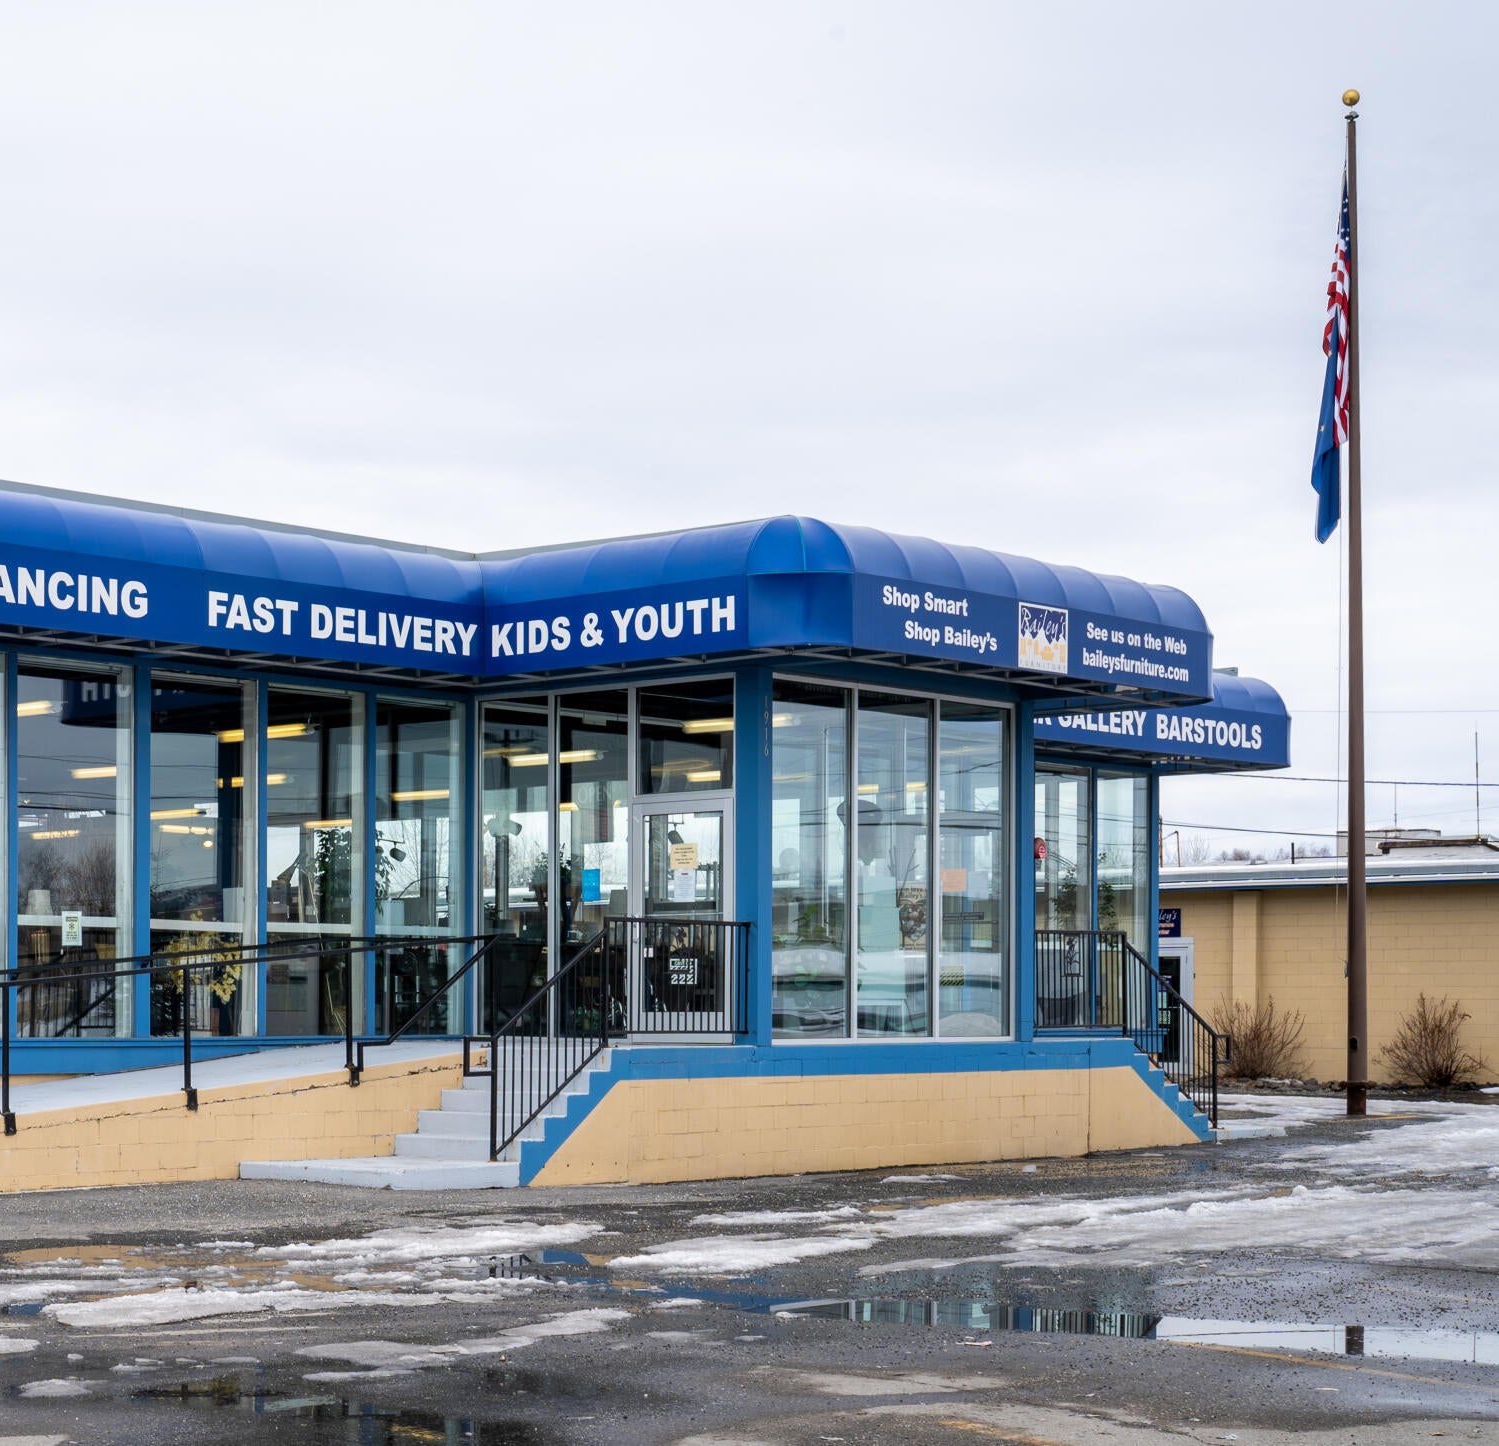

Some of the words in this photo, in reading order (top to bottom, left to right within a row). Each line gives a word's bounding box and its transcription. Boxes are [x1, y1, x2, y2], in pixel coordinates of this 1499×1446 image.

[882, 585, 920, 614] Shop
[924, 592, 968, 617] Smart
[208, 590, 299, 636] FAST
[310, 603, 478, 657] DELIVERY
[491, 616, 571, 658] KIDS
[580, 612, 604, 648] &
[610, 595, 736, 644] YOUTH
[904, 620, 941, 647] Shop
[944, 625, 998, 654] Bailey's
[1021, 607, 1066, 640] Bailey's
[1086, 622, 1108, 643] See
[1111, 629, 1124, 645] us
[1127, 632, 1141, 648] on
[1144, 631, 1162, 651] the
[1164, 636, 1187, 656] Web
[1082, 647, 1189, 683] baileysfurniture.com
[1156, 713, 1263, 750] BARSTOOLS
[1158, 910, 1178, 923] ley's
